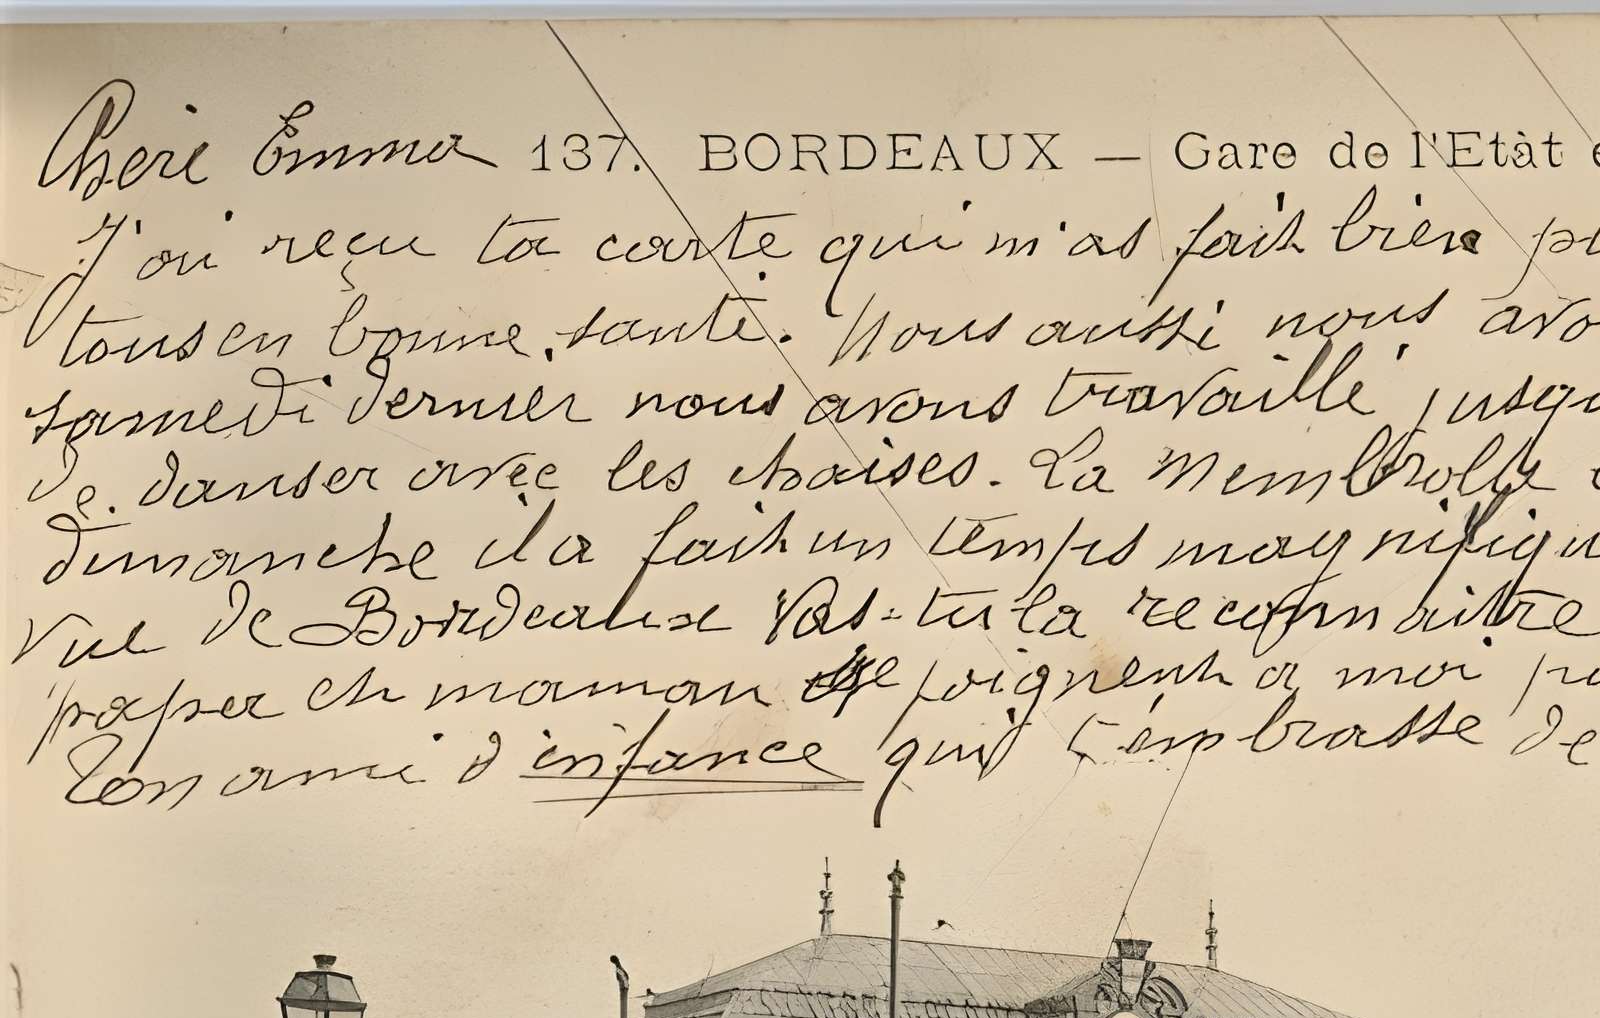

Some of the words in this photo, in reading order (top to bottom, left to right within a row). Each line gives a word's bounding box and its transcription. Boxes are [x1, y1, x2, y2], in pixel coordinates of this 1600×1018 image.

[252, 100, 498, 175] Emma
[262, 228, 436, 292] reçu
[478, 214, 561, 263] ta
[596, 210, 797, 263] carte
[818, 200, 962, 317] qui
[1147, 192, 1304, 307] fait
[1331, 184, 1480, 256] bien
[60, 304, 207, 367] tous
[216, 320, 292, 357] en
[328, 293, 530, 358] bonne
[828, 293, 1012, 367] Nous
[1026, 299, 1220, 350] aussi
[1266, 288, 1449, 338] nous
[25, 367, 331, 443] samedi
[347, 346, 591, 423] dernier
[626, 383, 784, 420] nous
[804, 383, 1018, 425] avons
[139, 451, 377, 506] danser
[606, 440, 689, 490] les
[1029, 427, 1113, 492] La
[43, 514, 437, 584] dimanche
[620, 501, 788, 615] fait
[807, 530, 892, 566] un
[928, 513, 1149, 600] temps
[201, 580, 282, 648] de
[1011, 583, 1087, 639] la
[424, 679, 771, 710] maman
[1336, 636, 1483, 689] moi
[220, 733, 425, 796] ami
[1510, 705, 1597, 765] de
